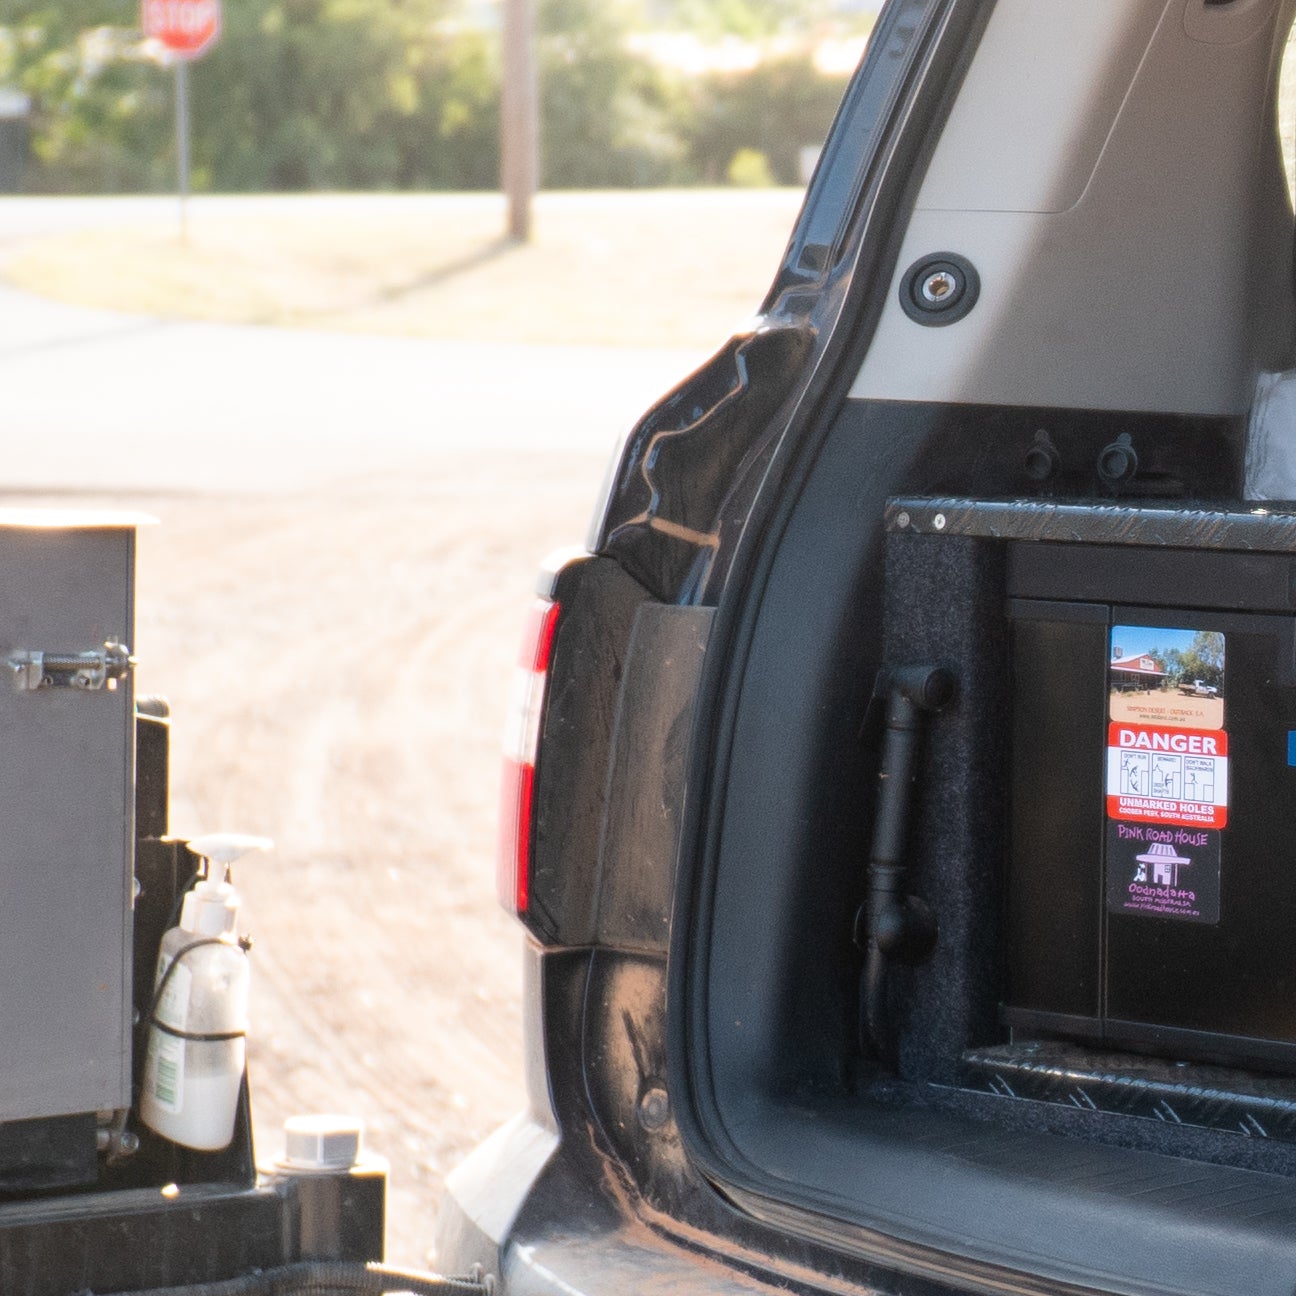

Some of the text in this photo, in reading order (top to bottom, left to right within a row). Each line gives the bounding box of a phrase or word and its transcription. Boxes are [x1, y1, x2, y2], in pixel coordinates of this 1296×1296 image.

[150, 0, 216, 34] STOP
[1120, 730, 1217, 754] DANGER
[1119, 797, 1215, 815] UNMARKED HOLES
[1118, 824, 1209, 847] PINK ROAD HOUSE
